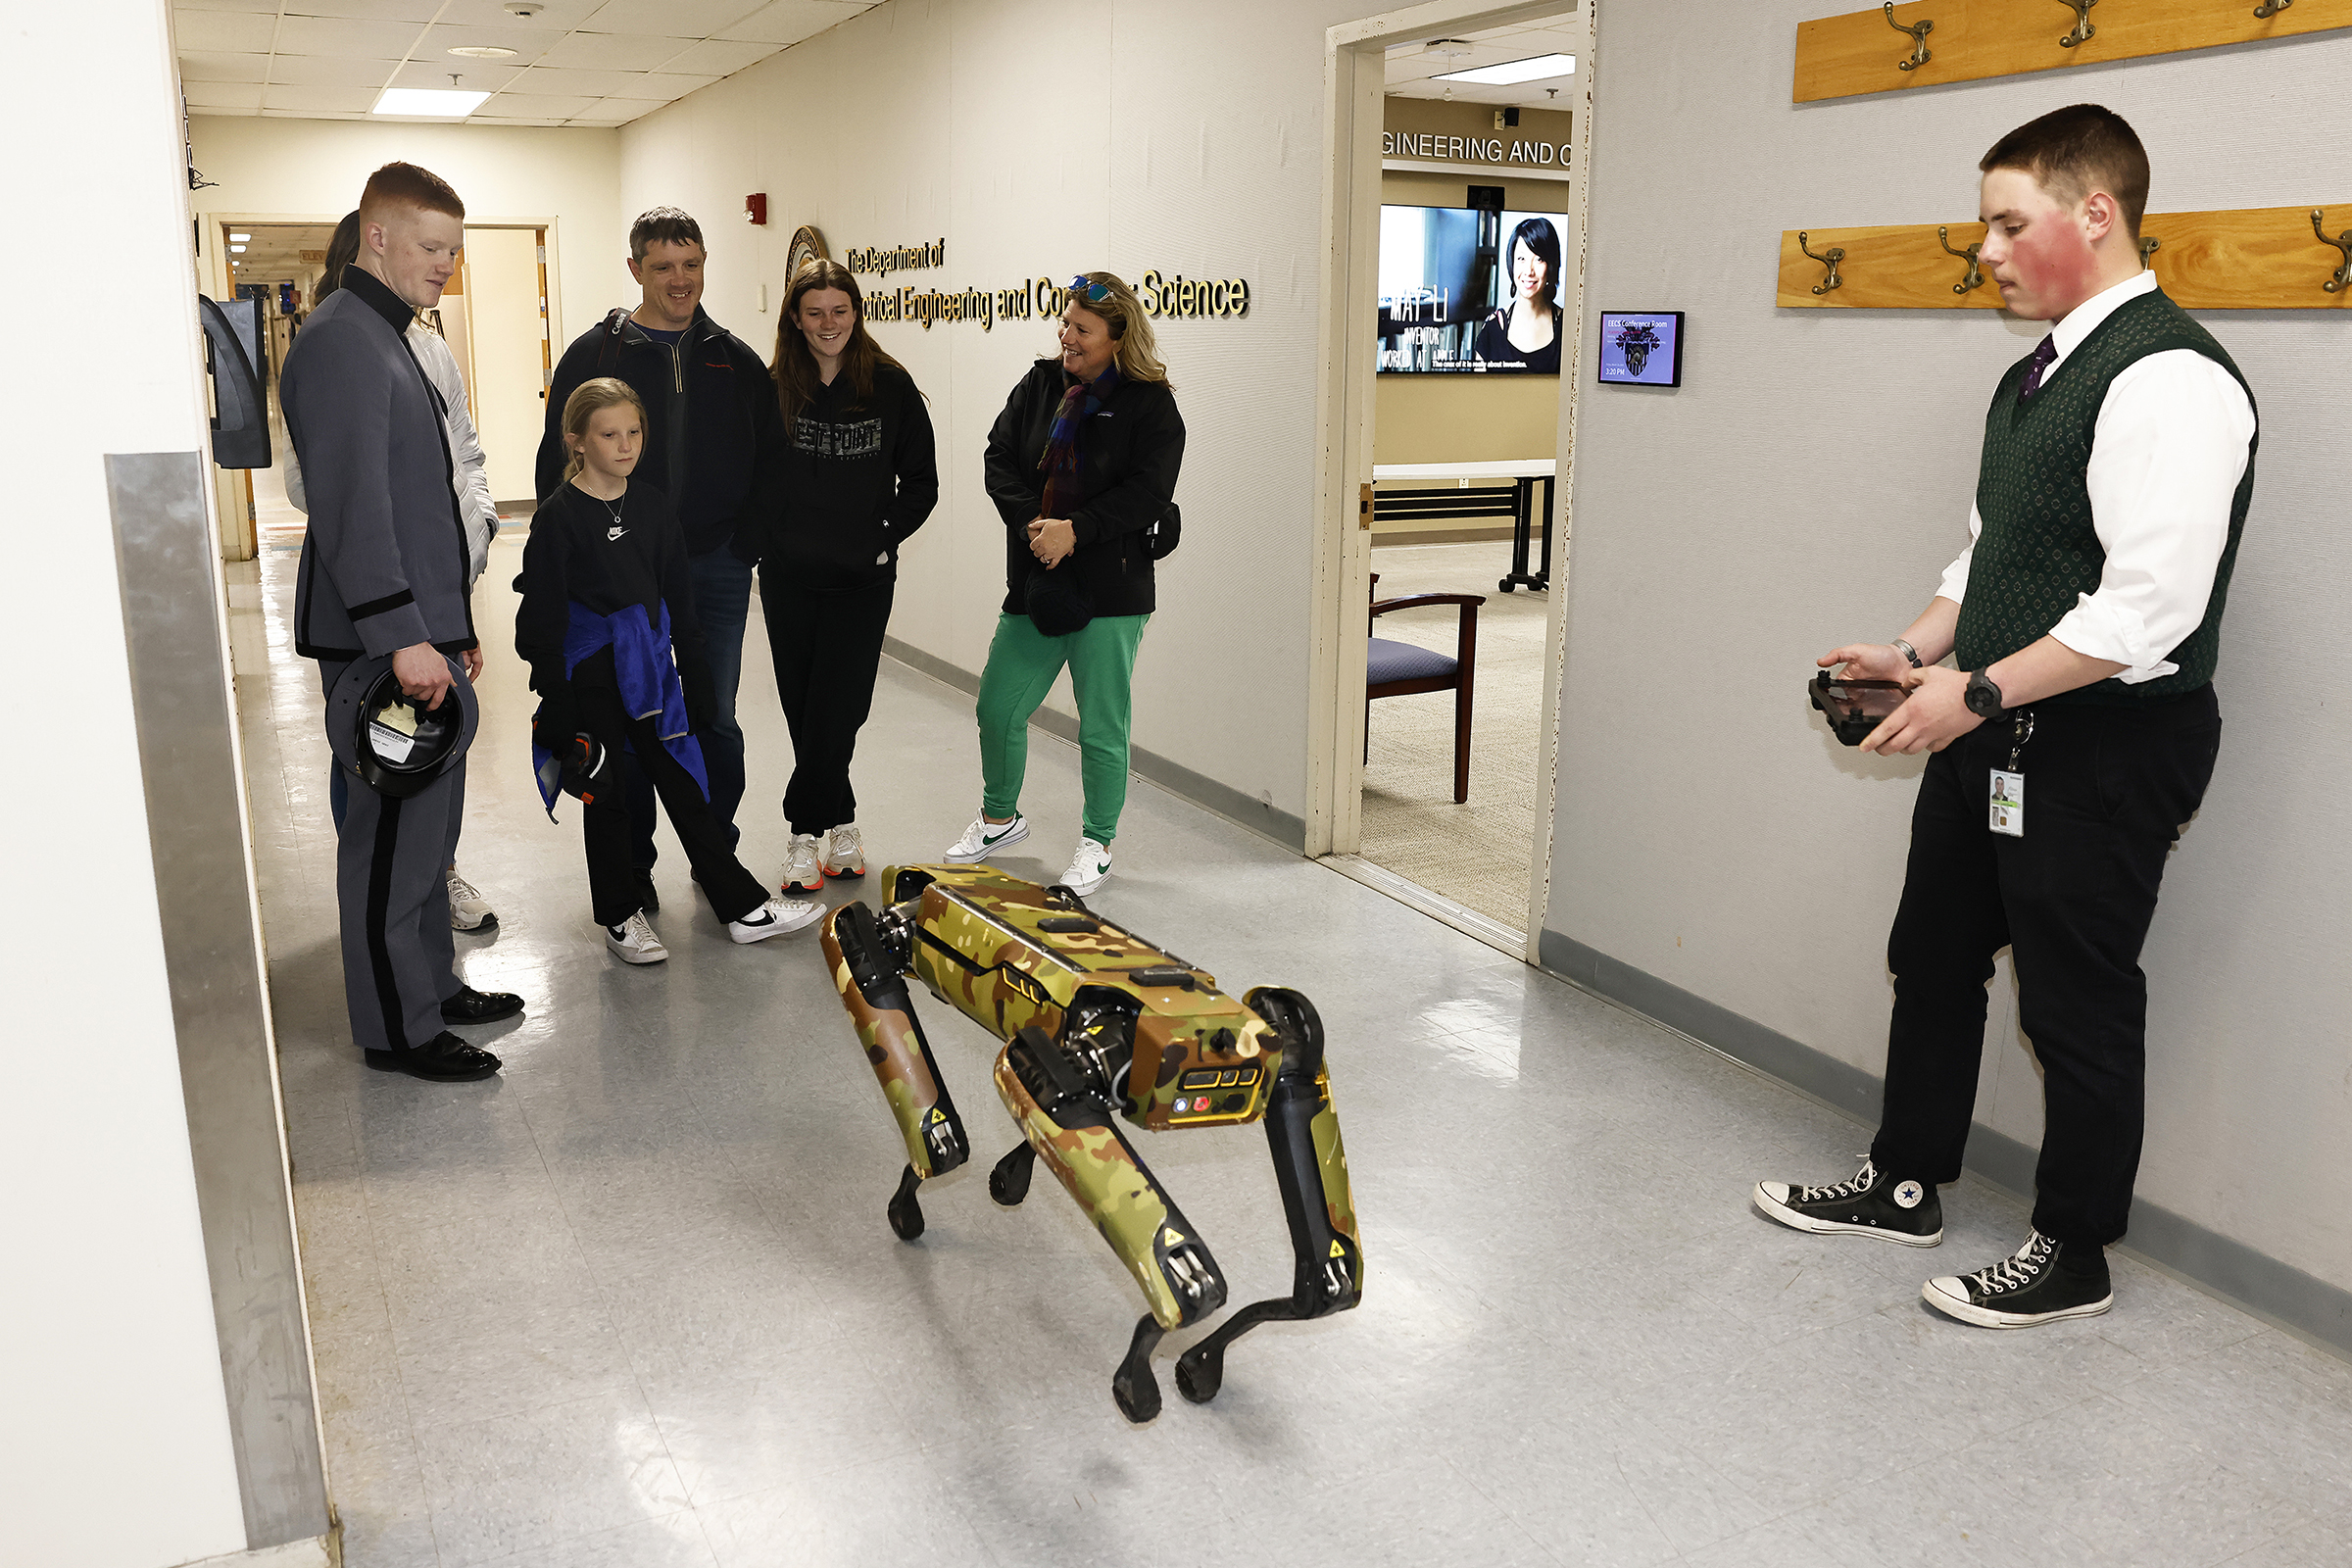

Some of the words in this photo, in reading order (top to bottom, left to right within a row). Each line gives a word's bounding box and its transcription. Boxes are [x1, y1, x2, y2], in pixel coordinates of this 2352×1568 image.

[1382, 130, 1502, 162] GINEERING
[1507, 140, 1554, 164] AND
[845, 248, 865, 273] The
[865, 241, 930, 278] Department
[930, 237, 946, 267] of
[862, 287, 901, 321] ctrical
[903, 285, 993, 330] Engineering
[996, 278, 1031, 320] and
[1142, 269, 1250, 318] Science
[612, 313, 627, 335] Canon
[1403, 326, 1440, 346] INVENTOR
[1381, 350, 1411, 368] WORKED
[1416, 350, 1427, 368] AT
